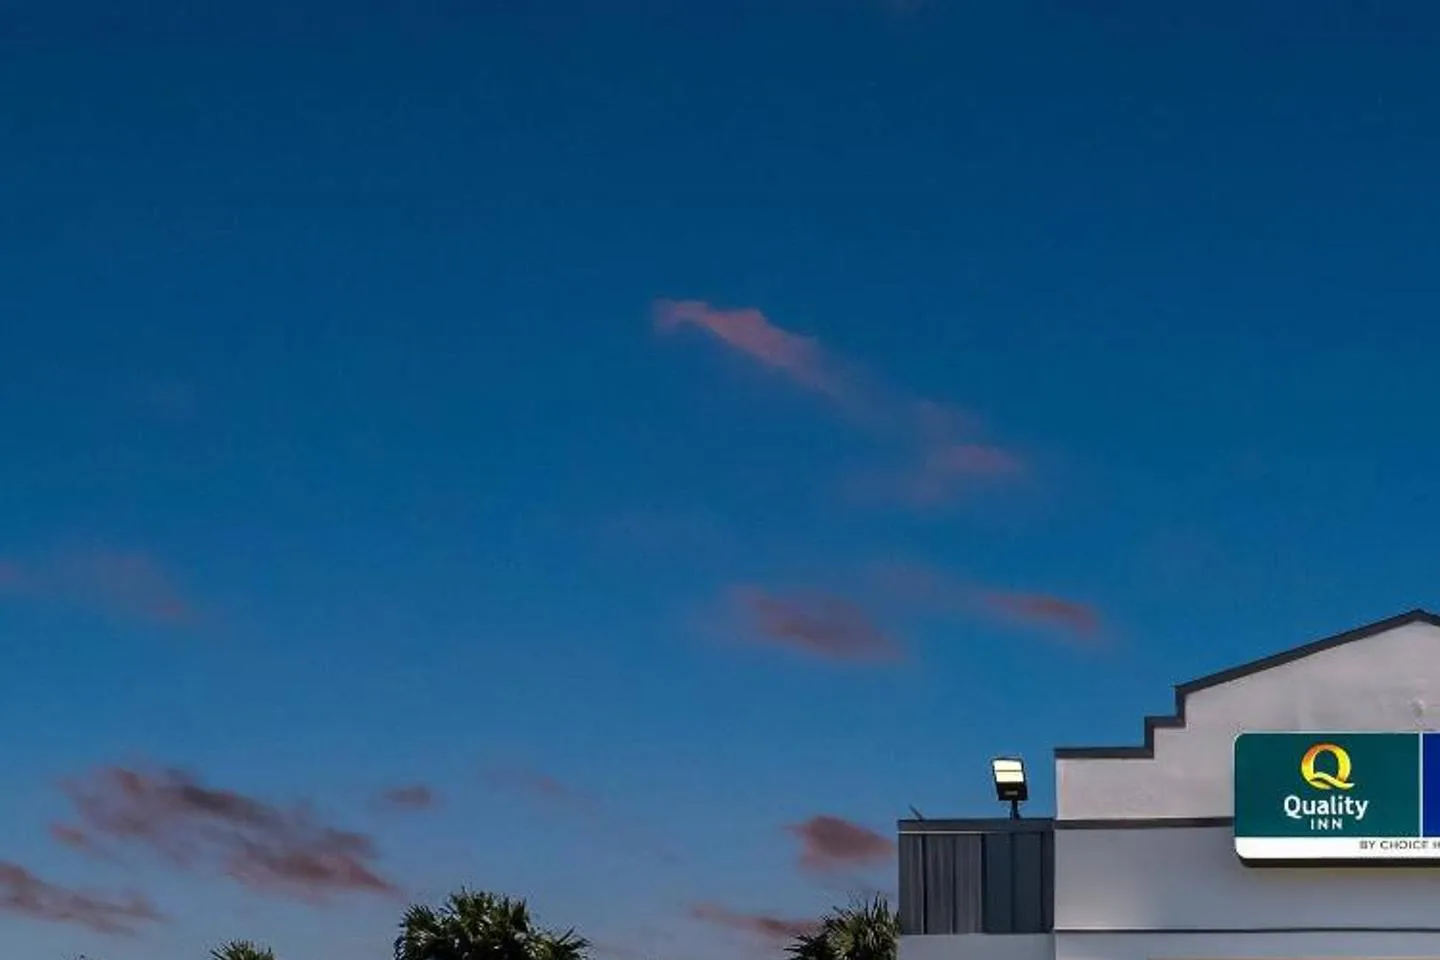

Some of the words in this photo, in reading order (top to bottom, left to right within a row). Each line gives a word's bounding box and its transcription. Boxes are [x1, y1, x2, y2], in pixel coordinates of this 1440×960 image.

[1283, 795, 1369, 820] Quality
[1310, 818, 1344, 830] INN
[1359, 840, 1375, 850] BY
[1380, 840, 1429, 850] CHOICE
